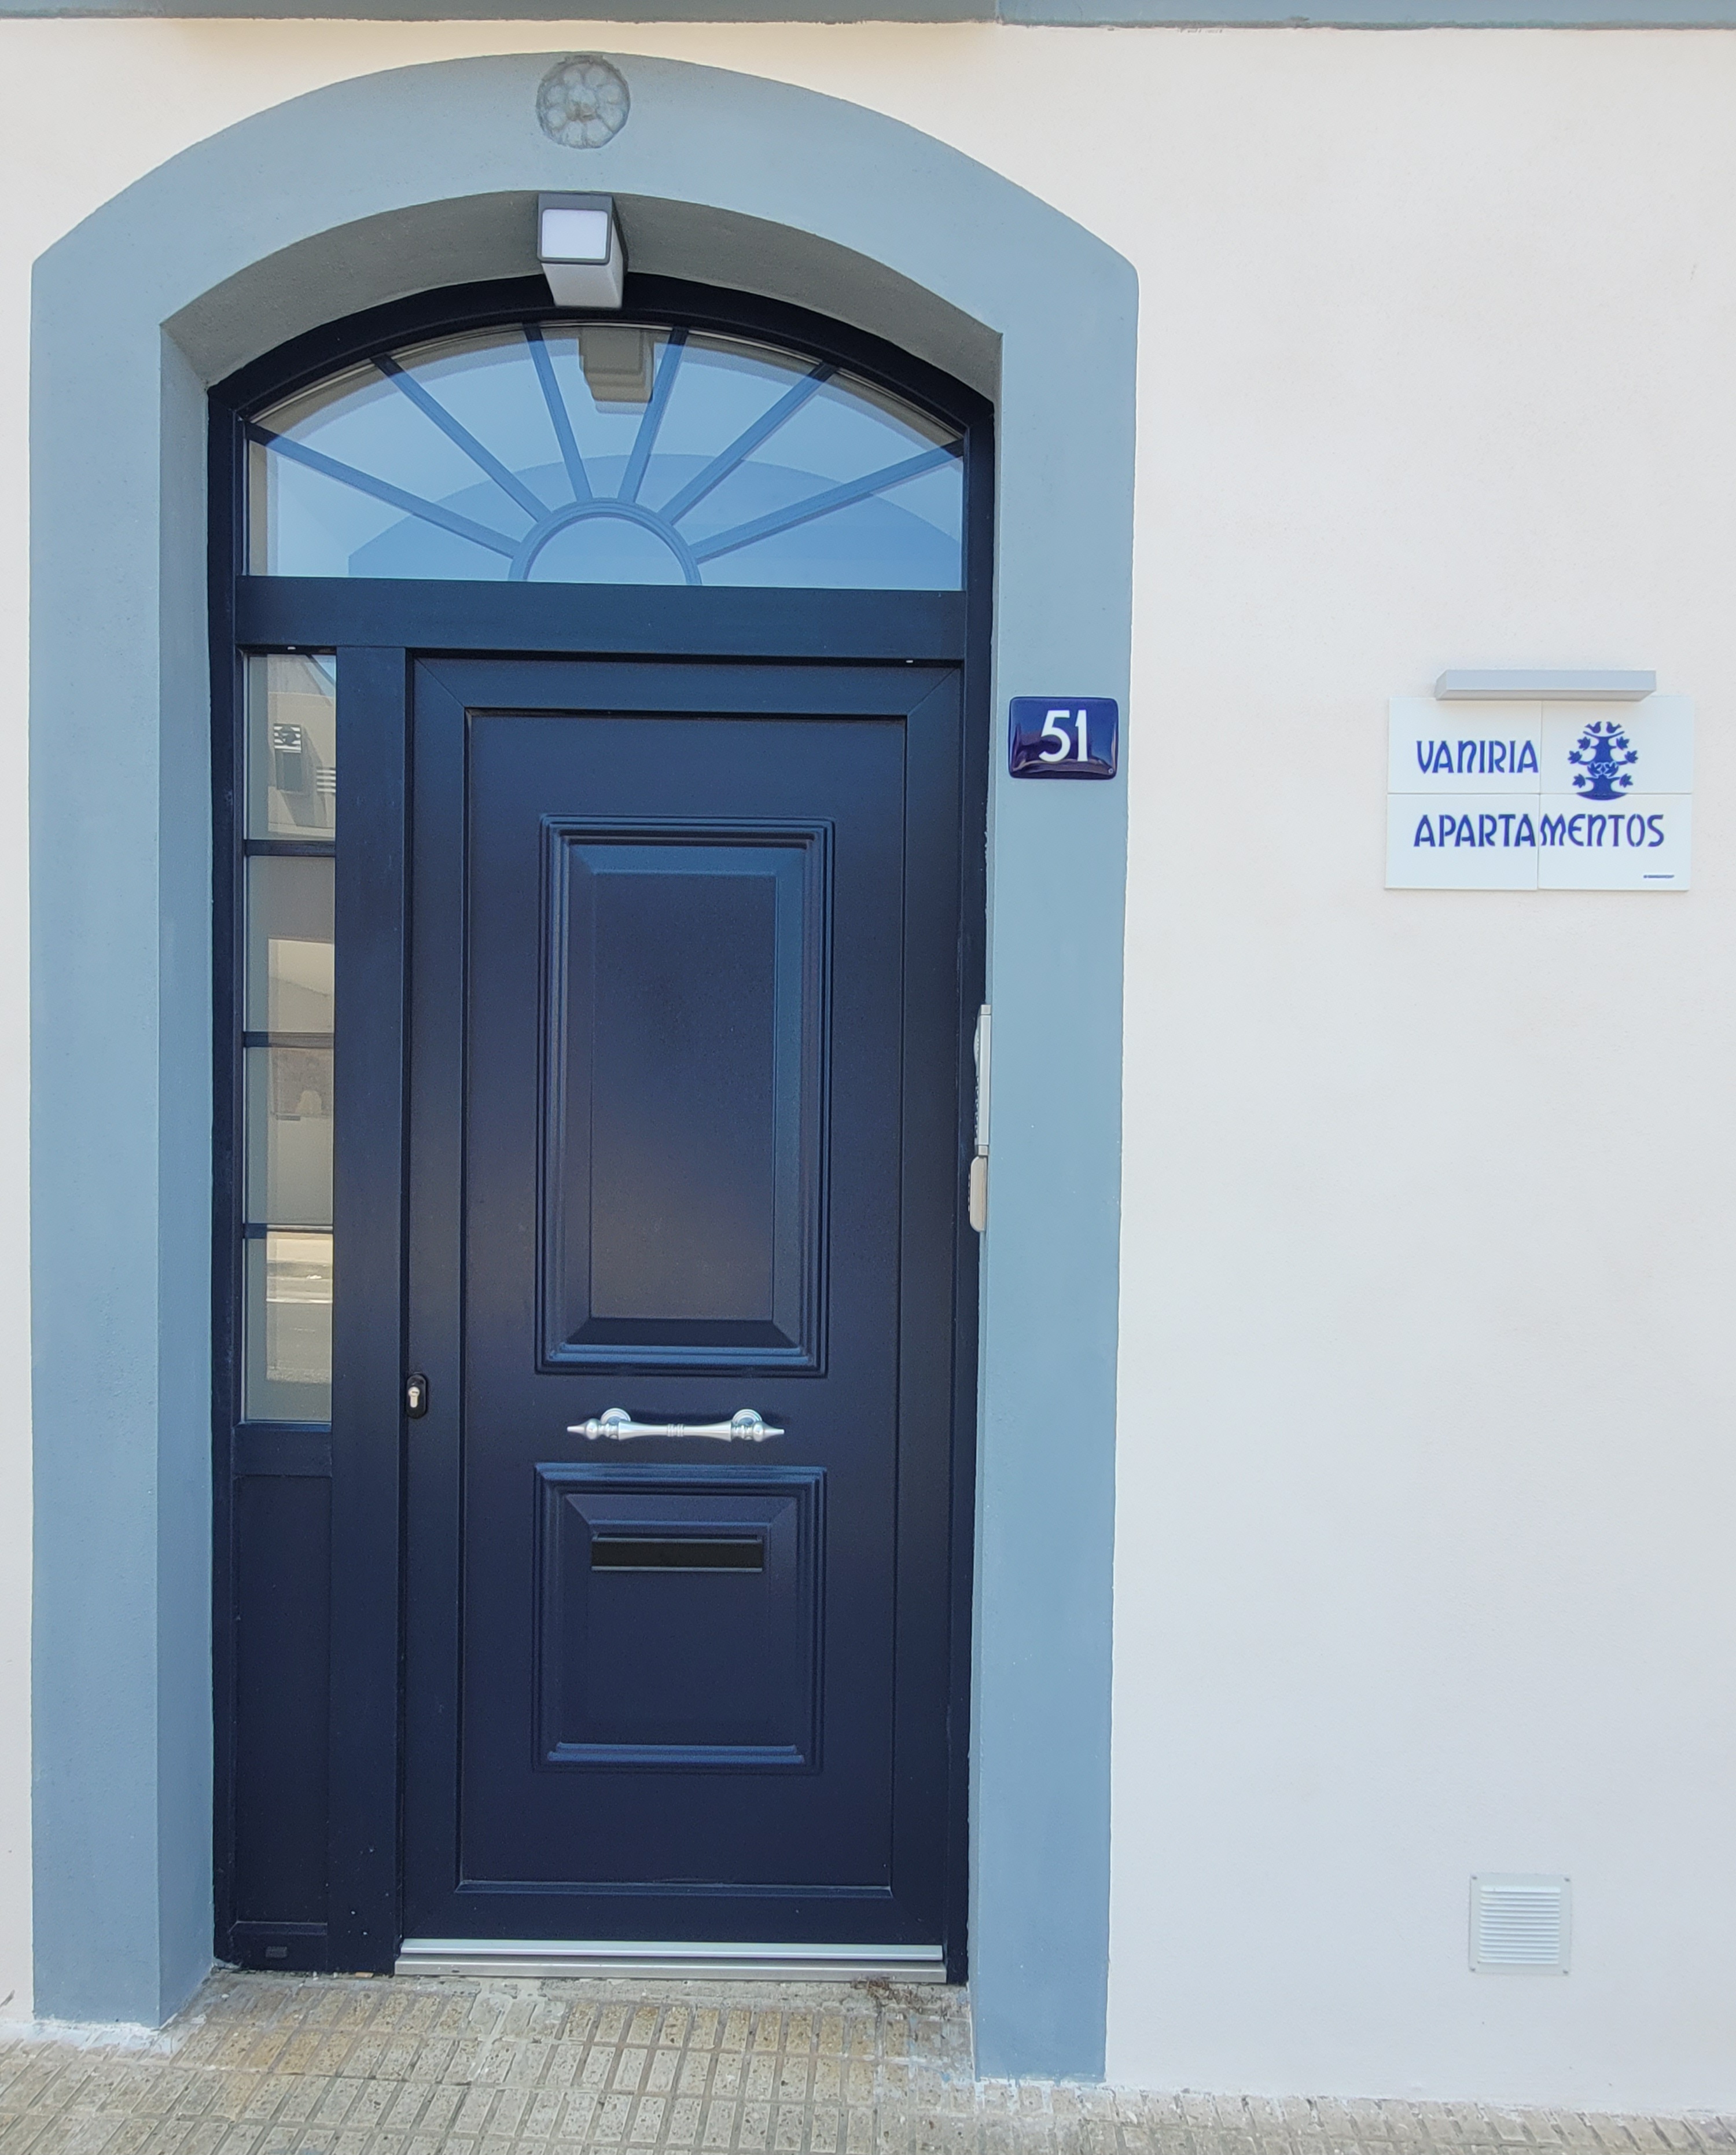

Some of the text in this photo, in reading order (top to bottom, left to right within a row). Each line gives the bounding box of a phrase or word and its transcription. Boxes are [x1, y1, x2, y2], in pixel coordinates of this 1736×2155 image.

[1039, 709, 1088, 762] 51
[1416, 740, 1539, 774] VANIRIA
[1413, 813, 1665, 848] APARTAMENTOS
